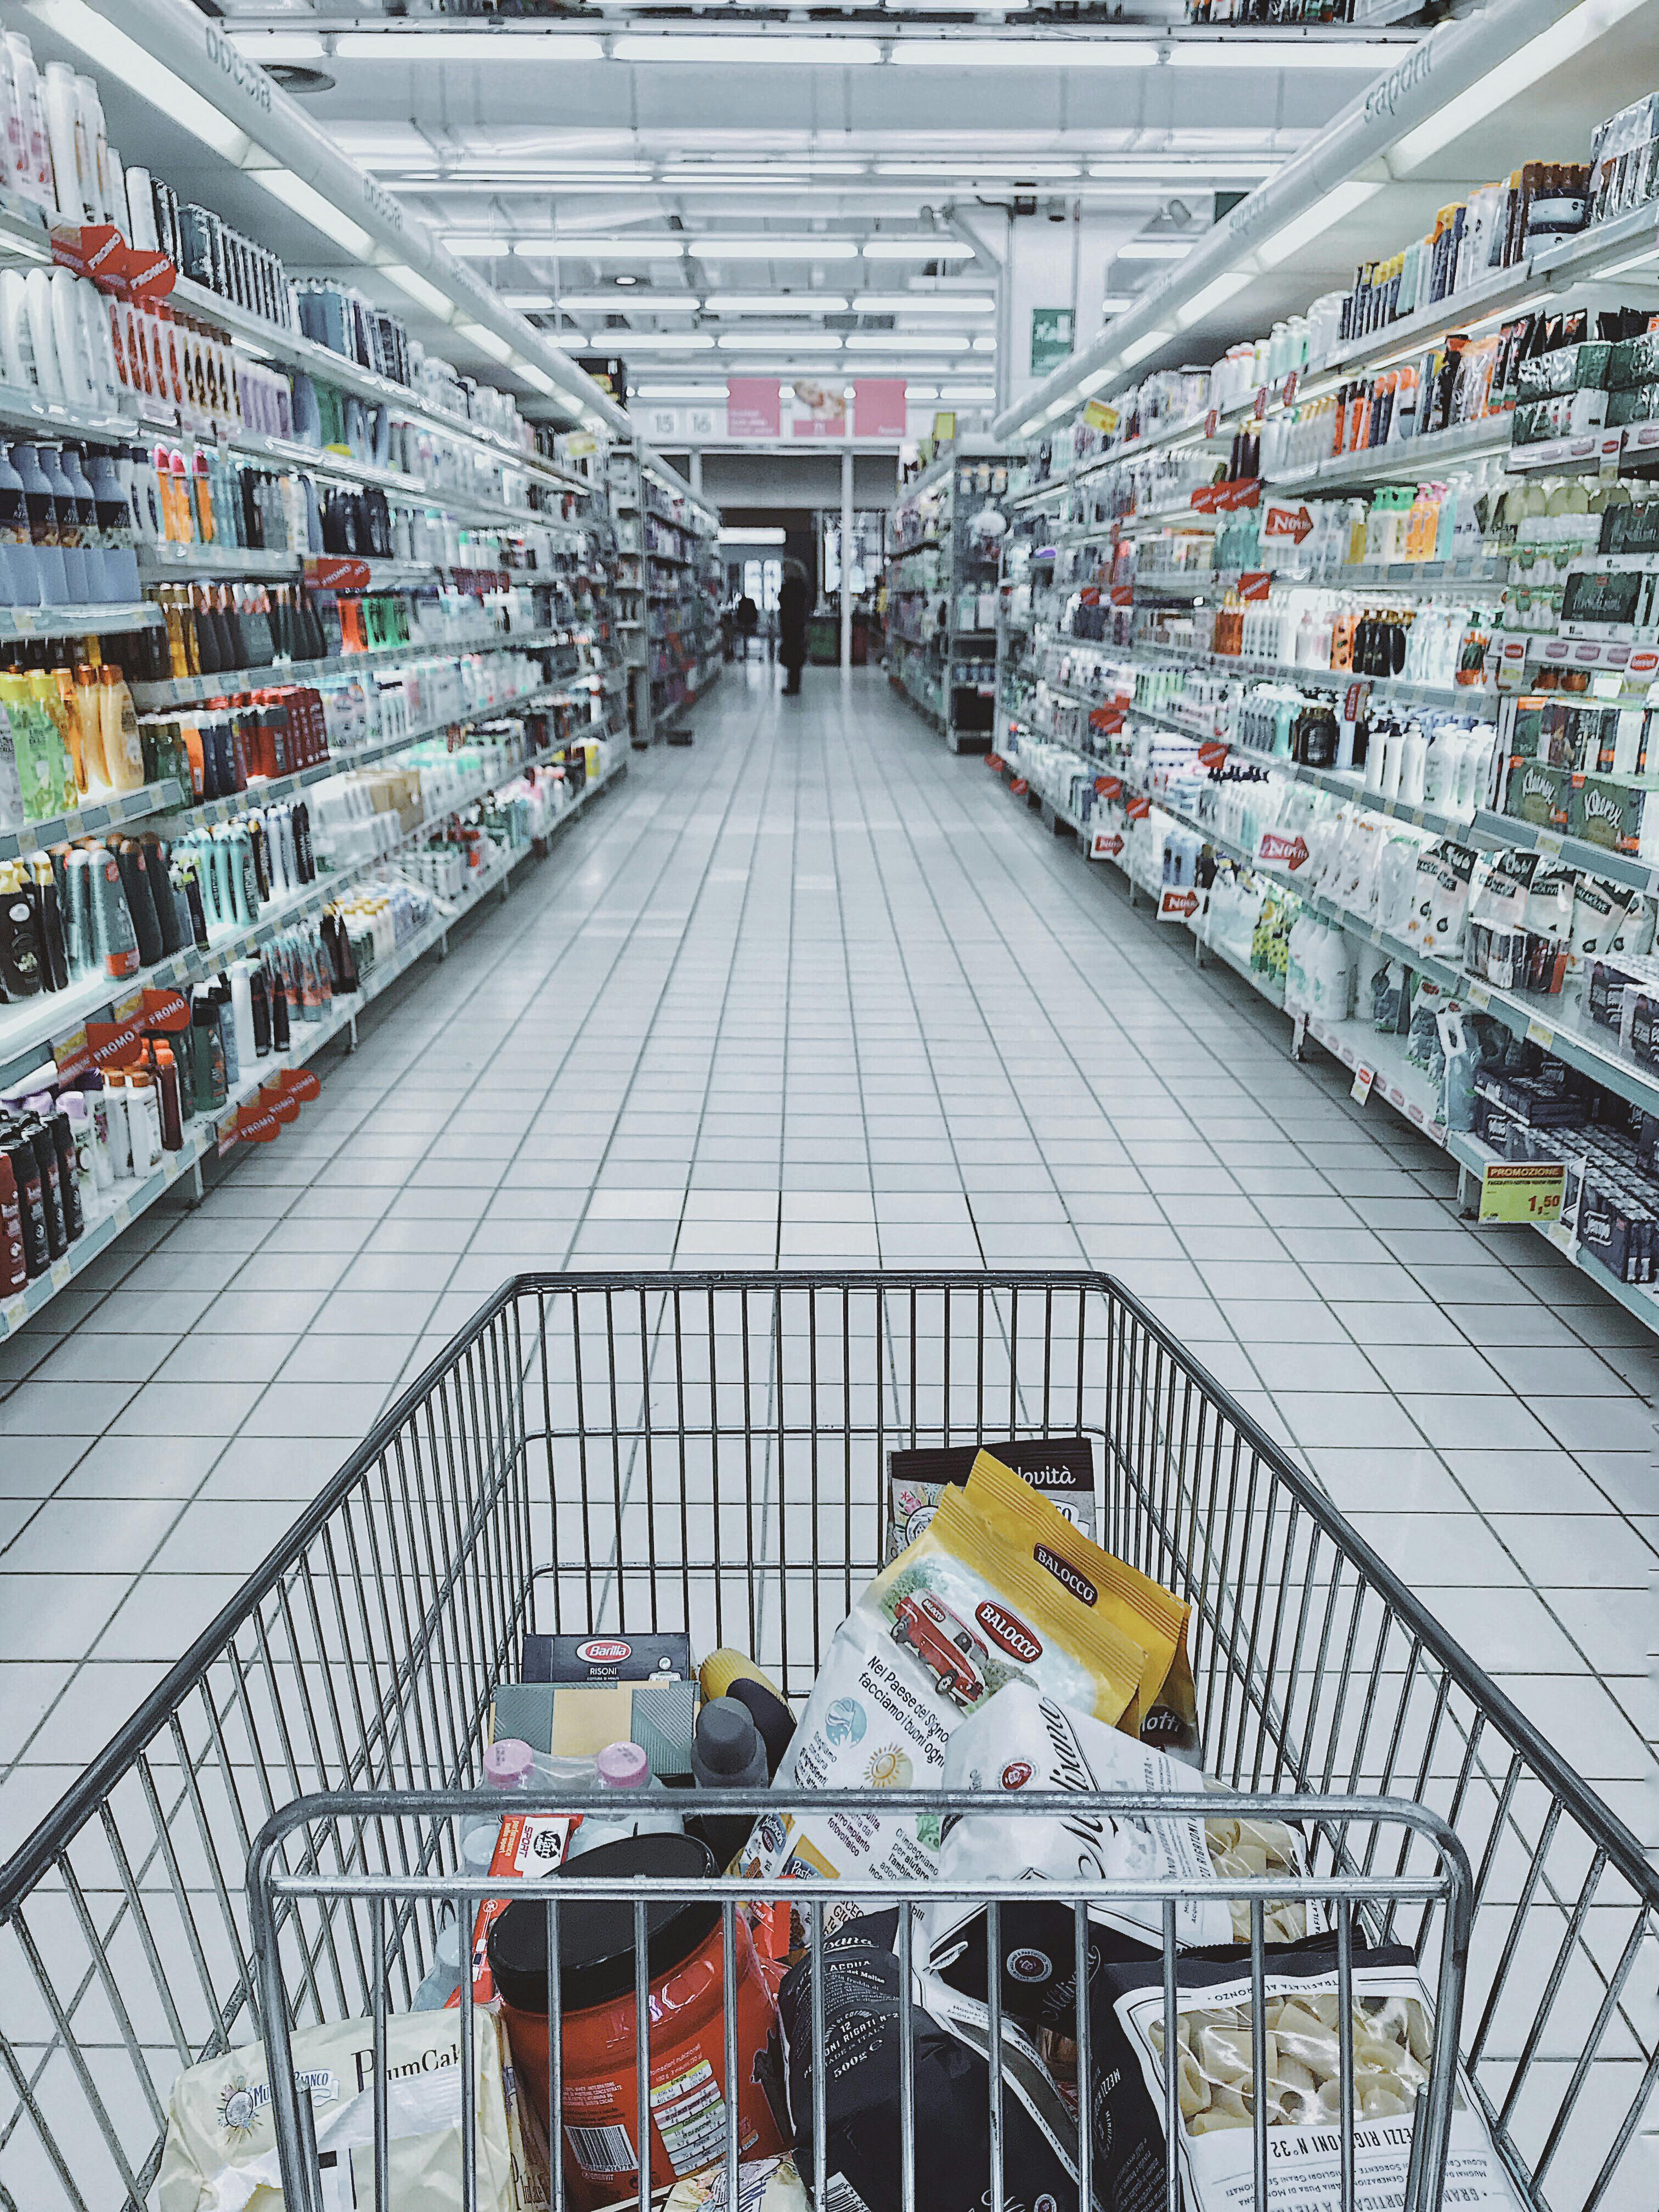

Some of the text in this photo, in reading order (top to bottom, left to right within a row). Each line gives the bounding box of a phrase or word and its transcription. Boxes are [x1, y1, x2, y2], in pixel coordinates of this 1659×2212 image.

[656, 414, 675, 433] 15
[693, 414, 712, 433] 16
[149, 998, 184, 1025] PROMO
[93, 1030, 135, 1063] PROMO
[269, 1096, 295, 1115] ROMO
[240, 1114, 275, 1137] PROMO
[1491, 1167, 1560, 1176] PROMOZIONE
[1527, 1195, 1561, 1215] 1,50
[1037, 1548, 1096, 1601] BALOCCO
[979, 1604, 1040, 1659] BALOCCO
[590, 1645, 627, 1657] Barilla
[590, 1667, 617, 1676] RISONI
[858, 1673, 904, 1720] facciamo
[867, 1656, 949, 1743] Nel Paese del Signo
[900, 1715, 910, 1726] i
[904, 1719, 929, 1747] buoni
[519, 1825, 533, 1858] SPORT
[827, 1817, 860, 1857] fotovoltaico
[847, 1822, 870, 1853] impianto
[1187, 1821, 1207, 1866] RIGATONI
[891, 1843, 906, 1858] per
[902, 1834, 939, 1876] impegniamo
[889, 1853, 918, 1880] l'ambie
[1311, 1899, 1321, 1934] AFILAT
[1214, 1987, 1254, 2001] RONZO
[839, 2021, 853, 2033] 12
[843, 2018, 877, 2044] RIGATI
[833, 2051, 868, 2078] 500g
[294, 2072, 330, 2086] BANCO
[1101, 2068, 1121, 2098] MEZZI
[1315, 2131, 1381, 2153] RIGONI
[1444, 2158, 1466, 2167] CR
[1280, 2173, 1307, 2185] GRANI
[1310, 2169, 1342, 2182] IGLIORI
[1355, 2175, 1404, 2187] GENERAZION
[1302, 2183, 1322, 2193] PURA
[1443, 2187, 1481, 2203] GRAN
